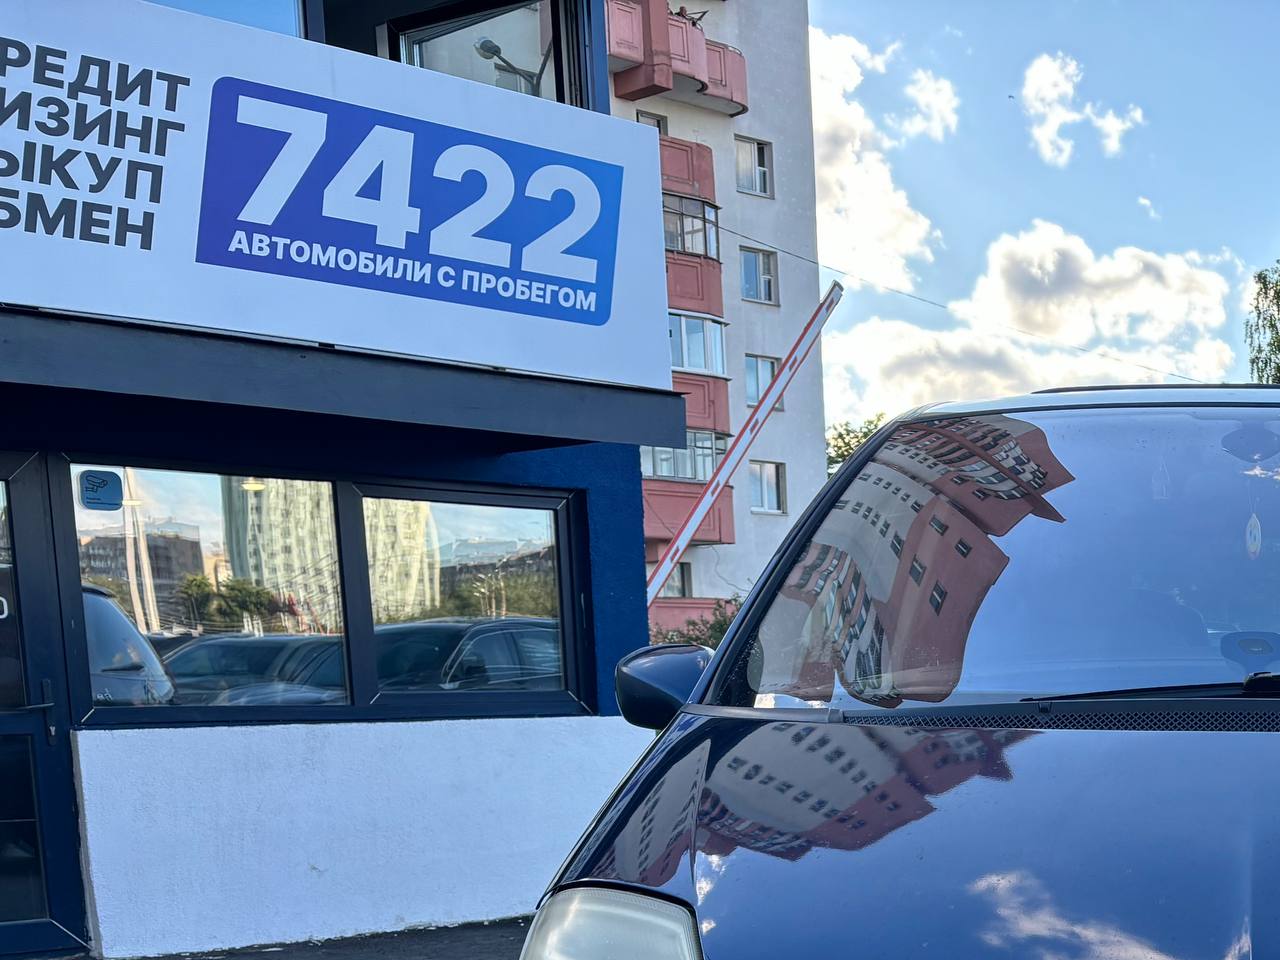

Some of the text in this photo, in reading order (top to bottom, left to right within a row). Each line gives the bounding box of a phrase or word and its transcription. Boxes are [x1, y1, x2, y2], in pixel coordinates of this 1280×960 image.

[236, 95, 602, 284] 7422
[228, 230, 597, 312] АВТОМОБИЛИ С ПРОБЕГОМ
